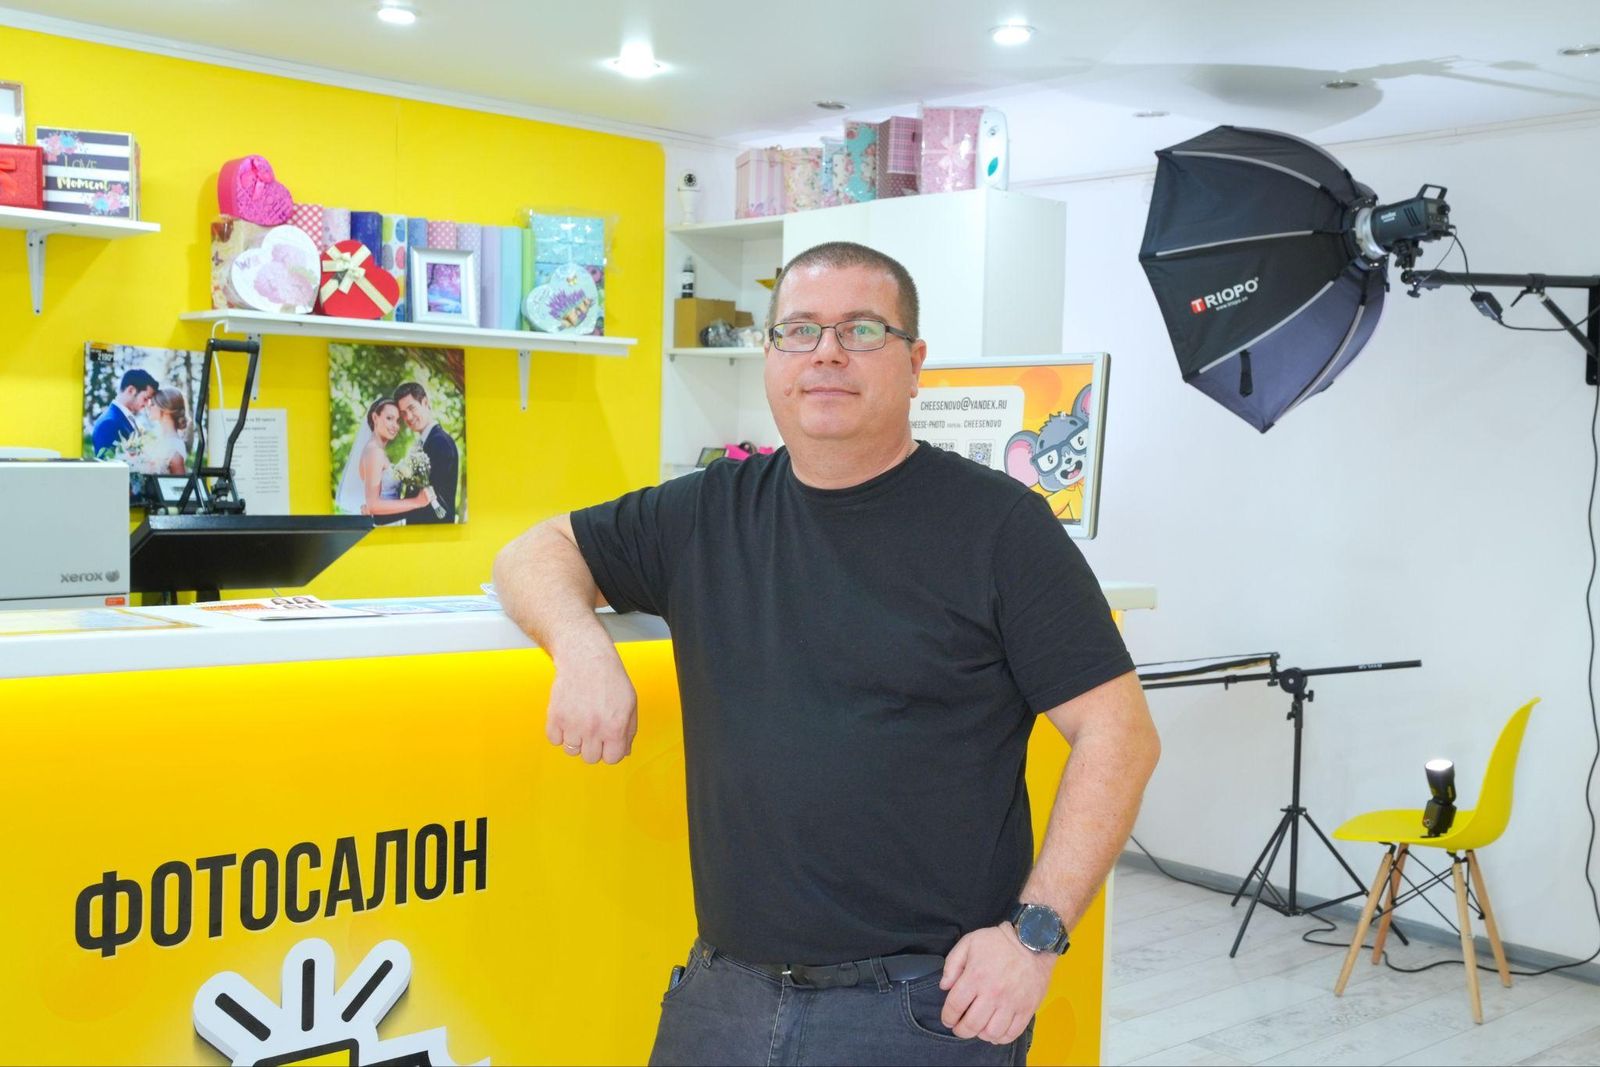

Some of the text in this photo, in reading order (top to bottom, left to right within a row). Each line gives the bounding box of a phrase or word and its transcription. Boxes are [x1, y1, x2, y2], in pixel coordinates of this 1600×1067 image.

[920, 397, 1008, 411] CHEESENOVO@YANDEX.RU
[963, 419, 1002, 429] CHEESENOVO
[60, 571, 103, 583] xerox
[75, 816, 488, 958] ФОТОСАЛОН
